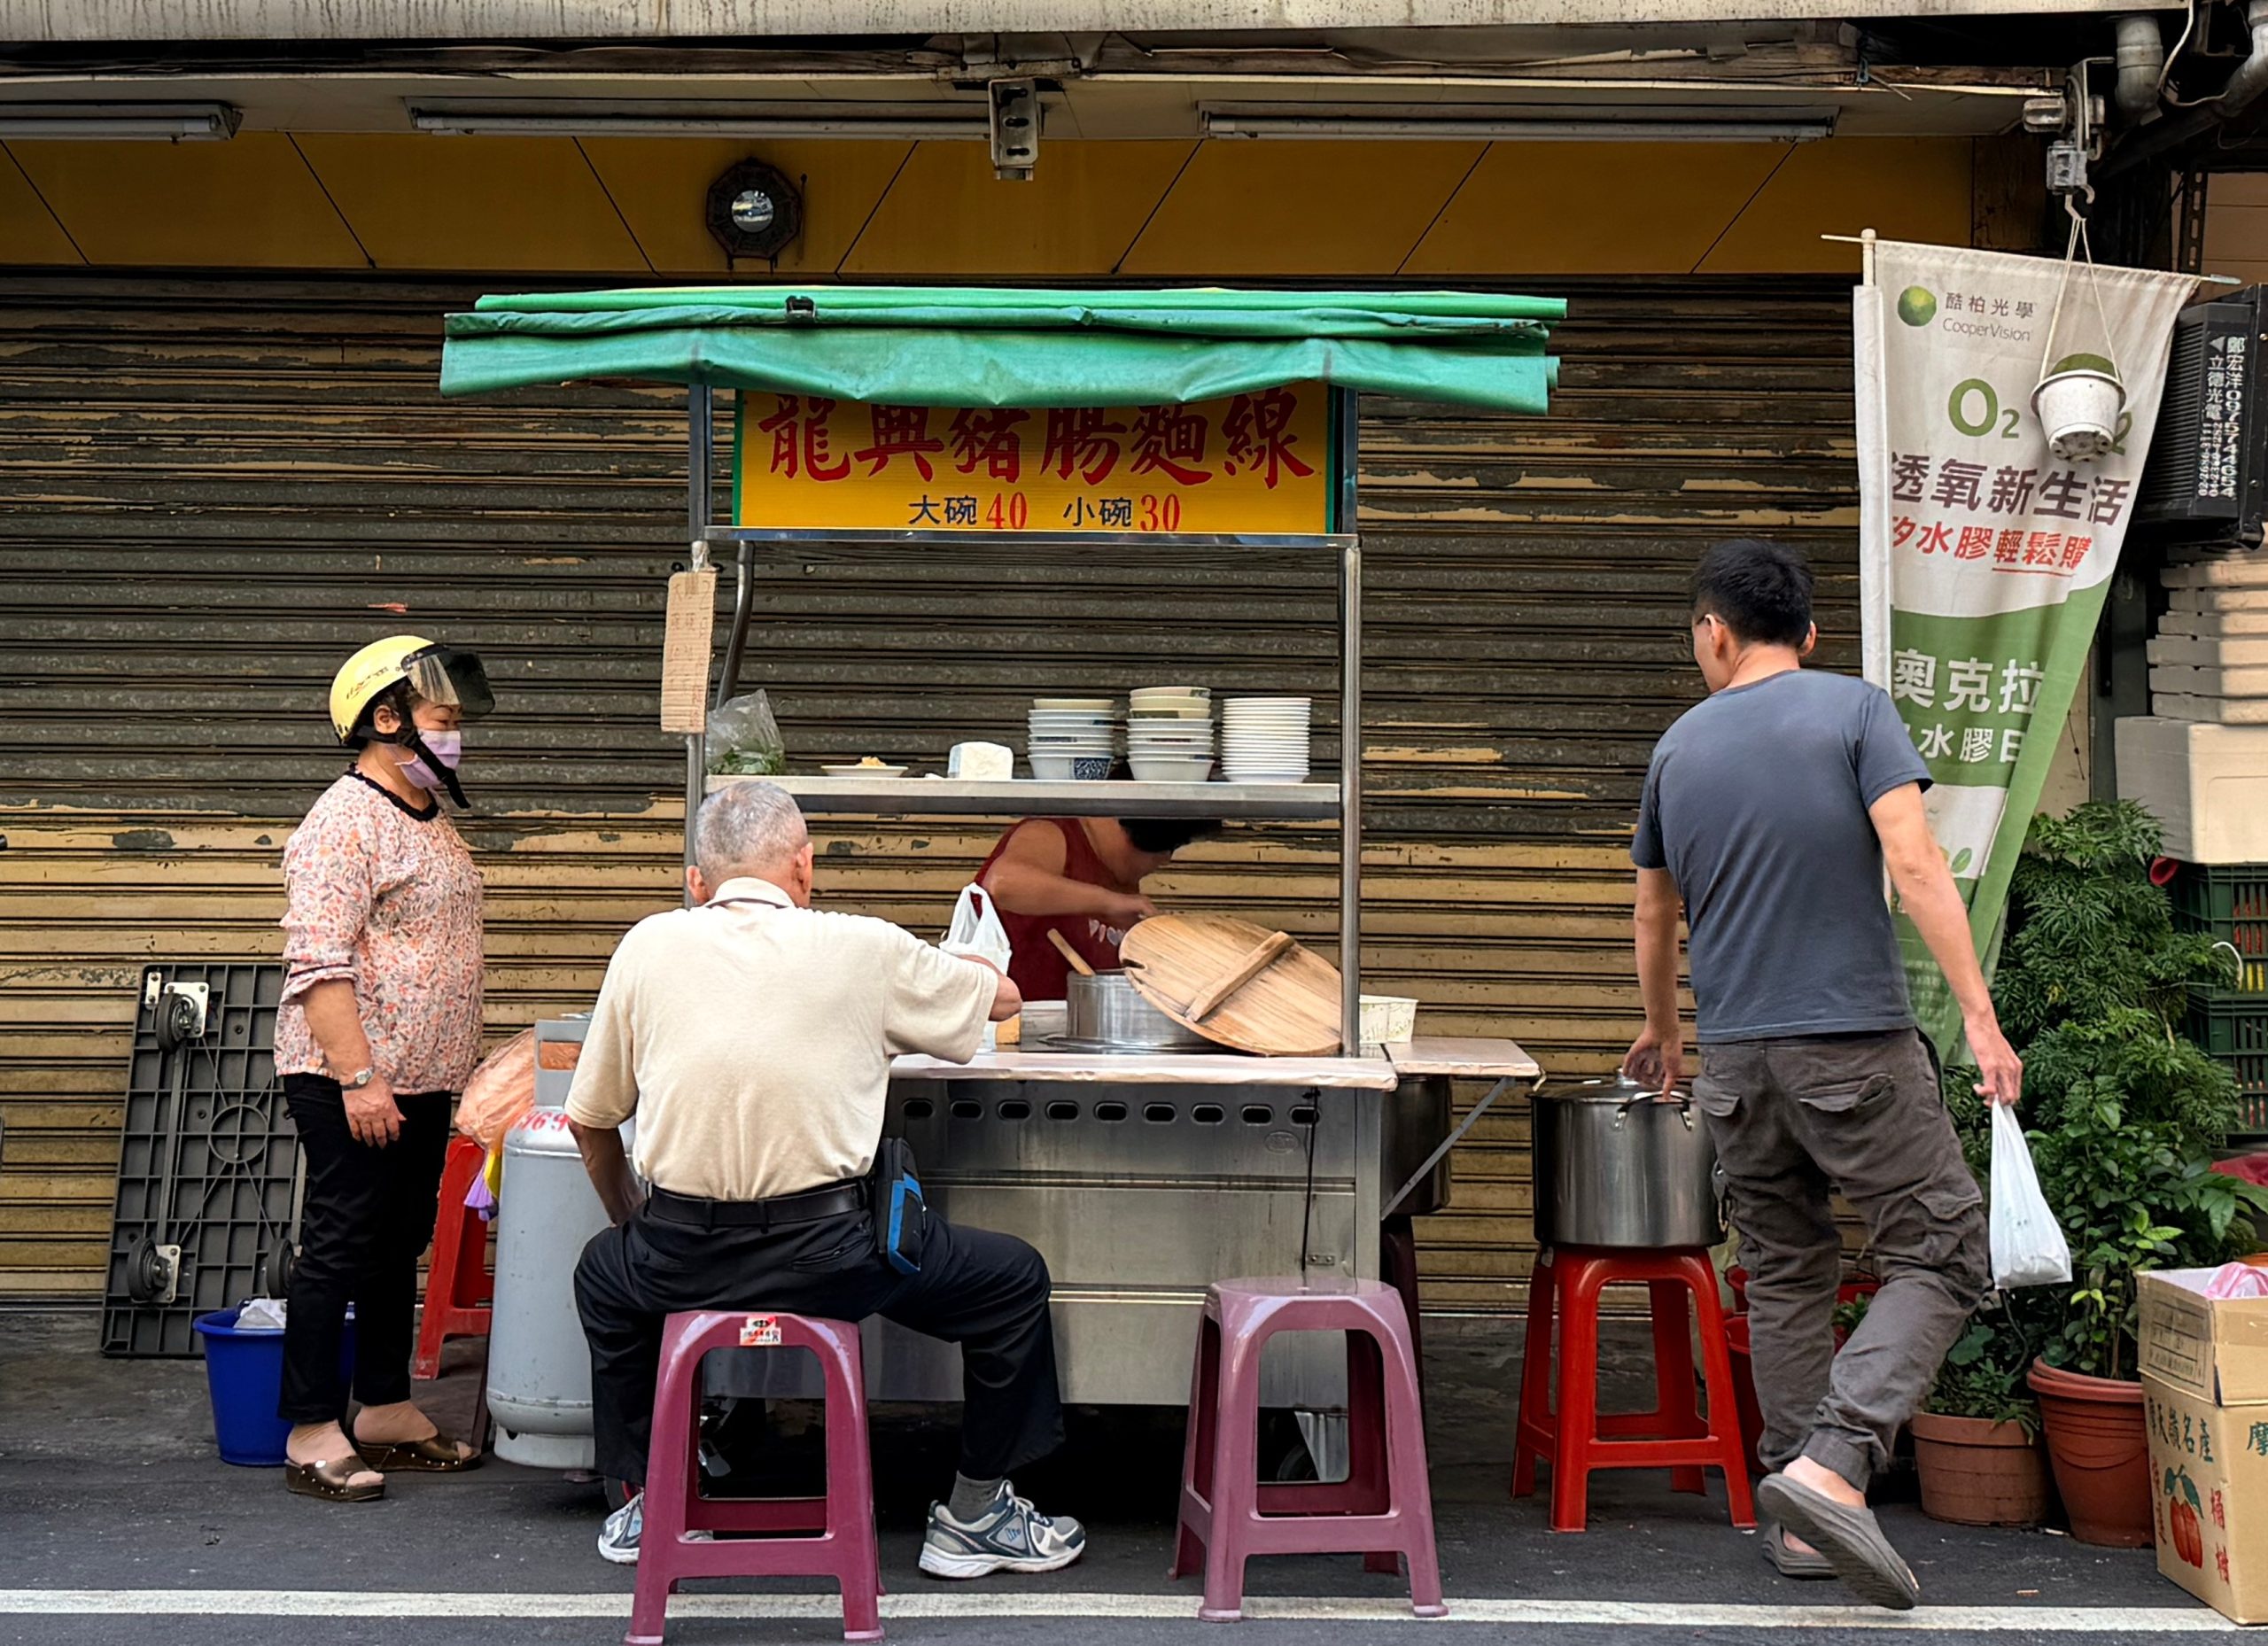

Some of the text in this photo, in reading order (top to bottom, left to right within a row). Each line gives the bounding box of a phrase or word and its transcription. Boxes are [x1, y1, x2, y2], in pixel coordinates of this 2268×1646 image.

[1943, 318, 2032, 342] CooperVision
[1946, 293, 2035, 319] 酷柏光學
[757, 387, 1316, 489] 龍興豬腸麵線
[1948, 378, 2019, 439] O2
[908, 491, 1182, 532] 大碗 40 小碗 30
[1892, 451, 2130, 525] 透氧新生活
[1894, 648, 2044, 714] 奧克拉
